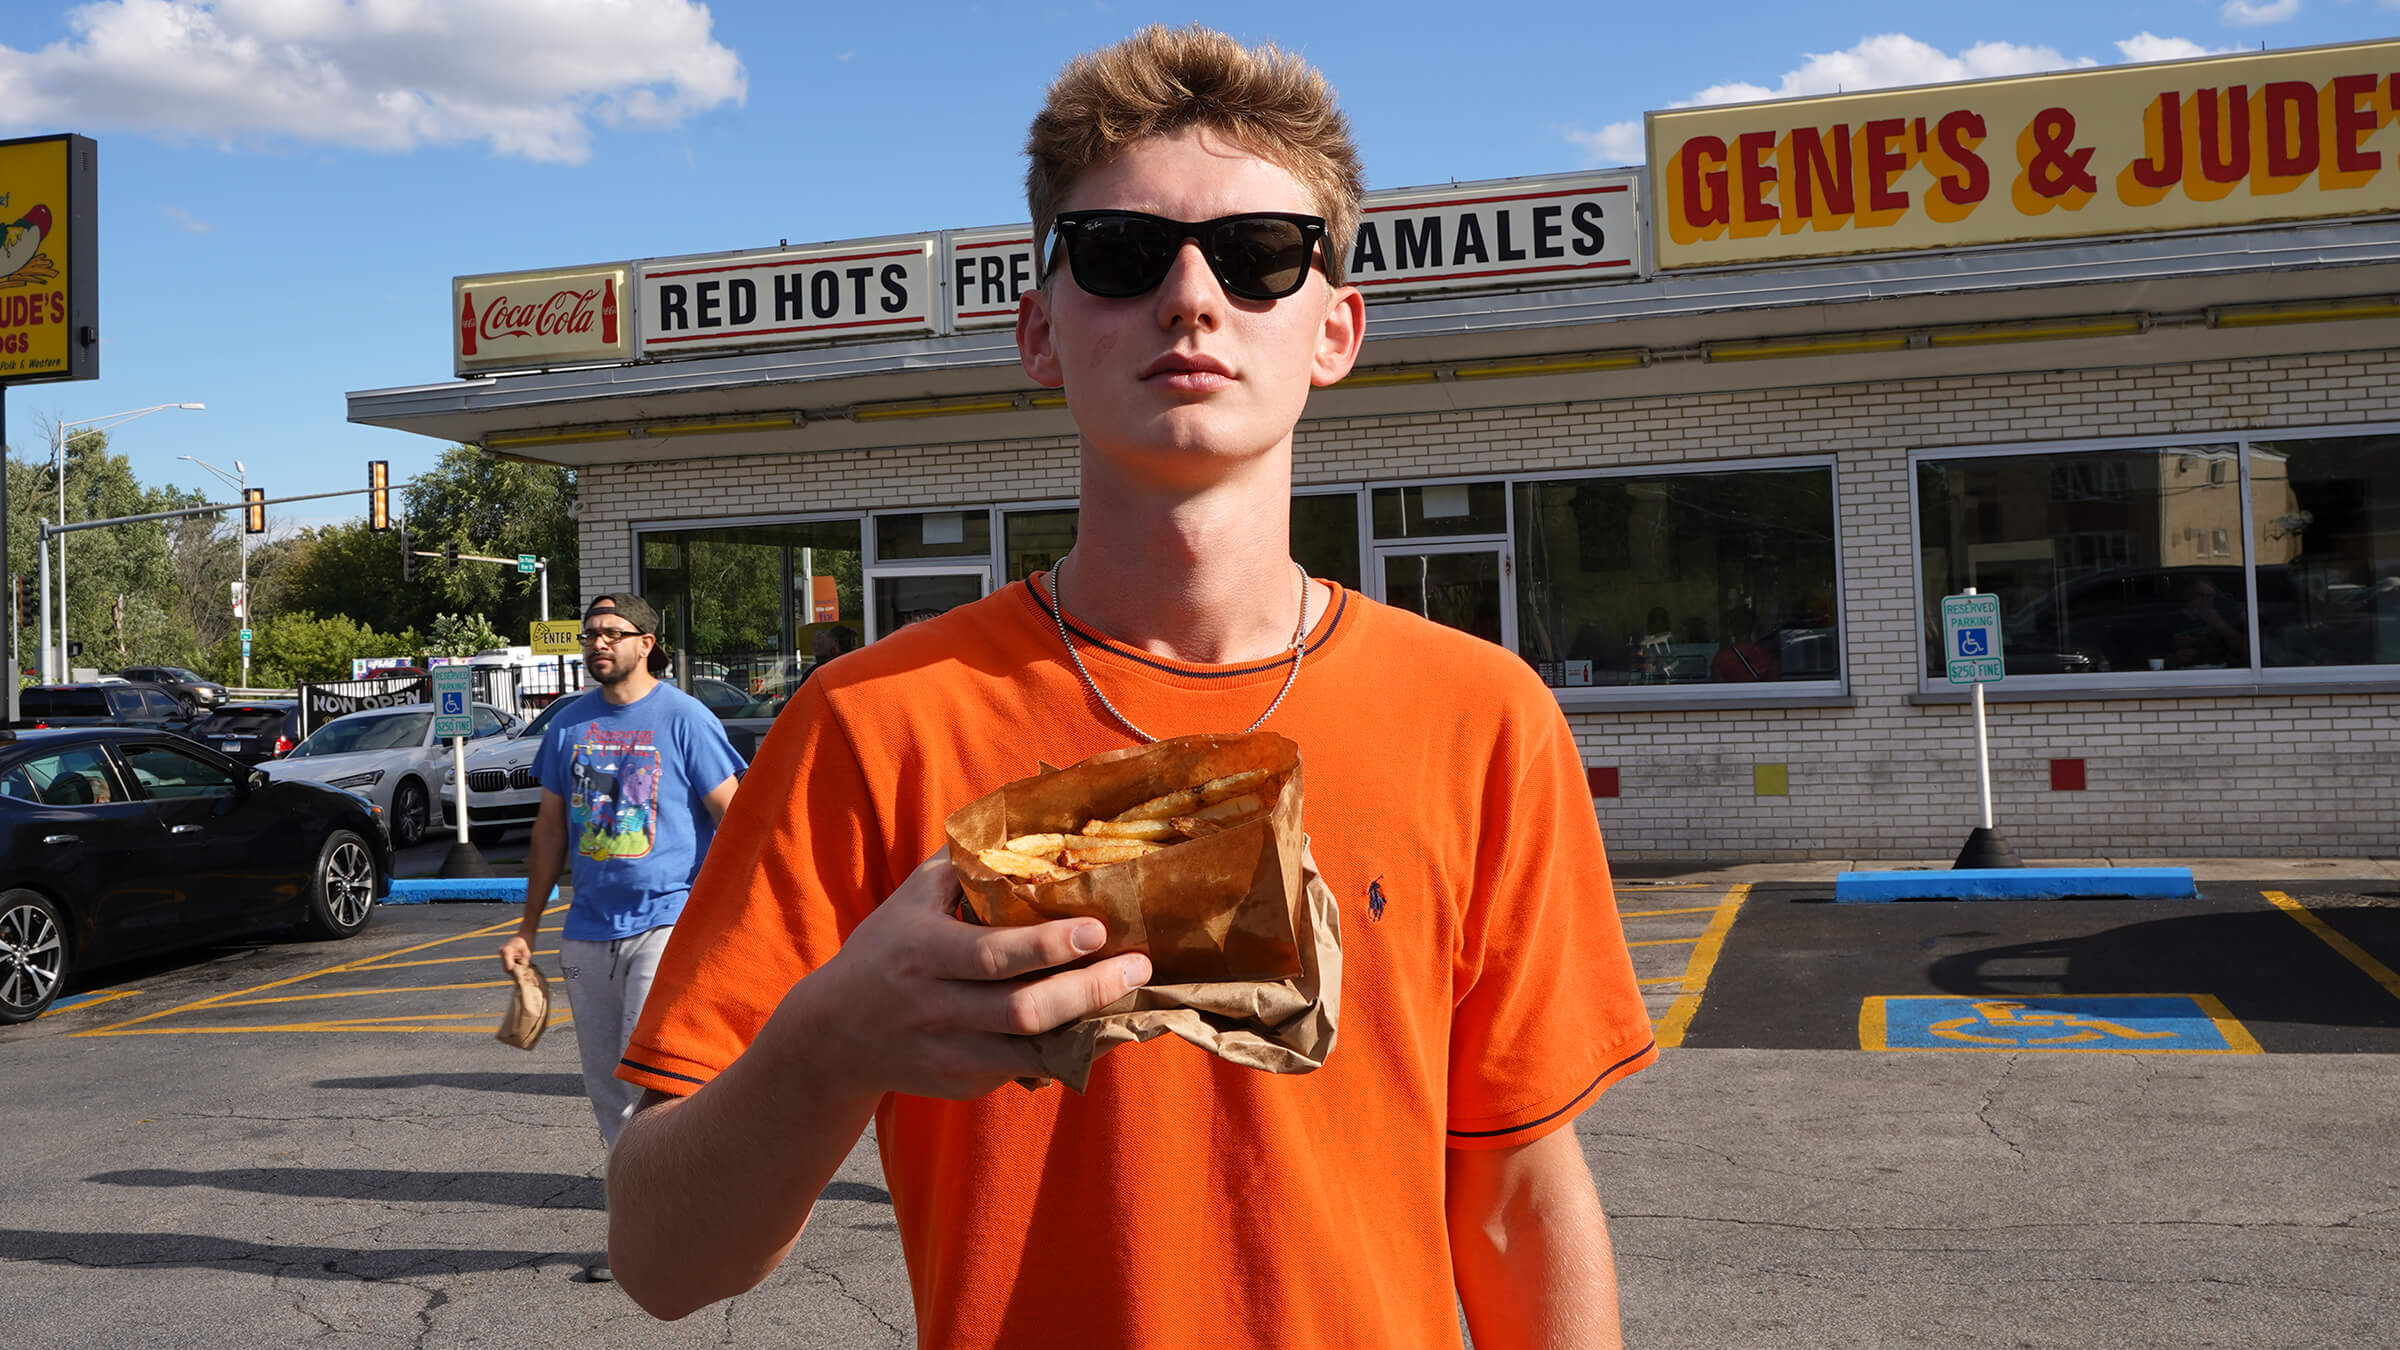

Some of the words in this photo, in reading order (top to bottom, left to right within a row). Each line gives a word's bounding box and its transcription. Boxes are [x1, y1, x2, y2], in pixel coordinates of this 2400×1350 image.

[1674, 109, 1990, 234] GENE'S
[2021, 108, 2097, 206] &
[660, 279, 757, 331] RED
[774, 263, 909, 321] HOTS
[480, 288, 601, 340] Coca-Cola
[1947, 602, 1995, 614] RESERVED
[1952, 616, 1993, 627] PARKING
[543, 632, 572, 644] ENTER
[436, 671, 468, 680] RESERVED
[1952, 665, 1975, 678] $250
[1978, 664, 1999, 676] FINE
[313, 694, 356, 713] NOW
[362, 690, 420, 711] OPEN
[438, 721, 454, 731] $250
[456, 721, 470, 731] FINE
